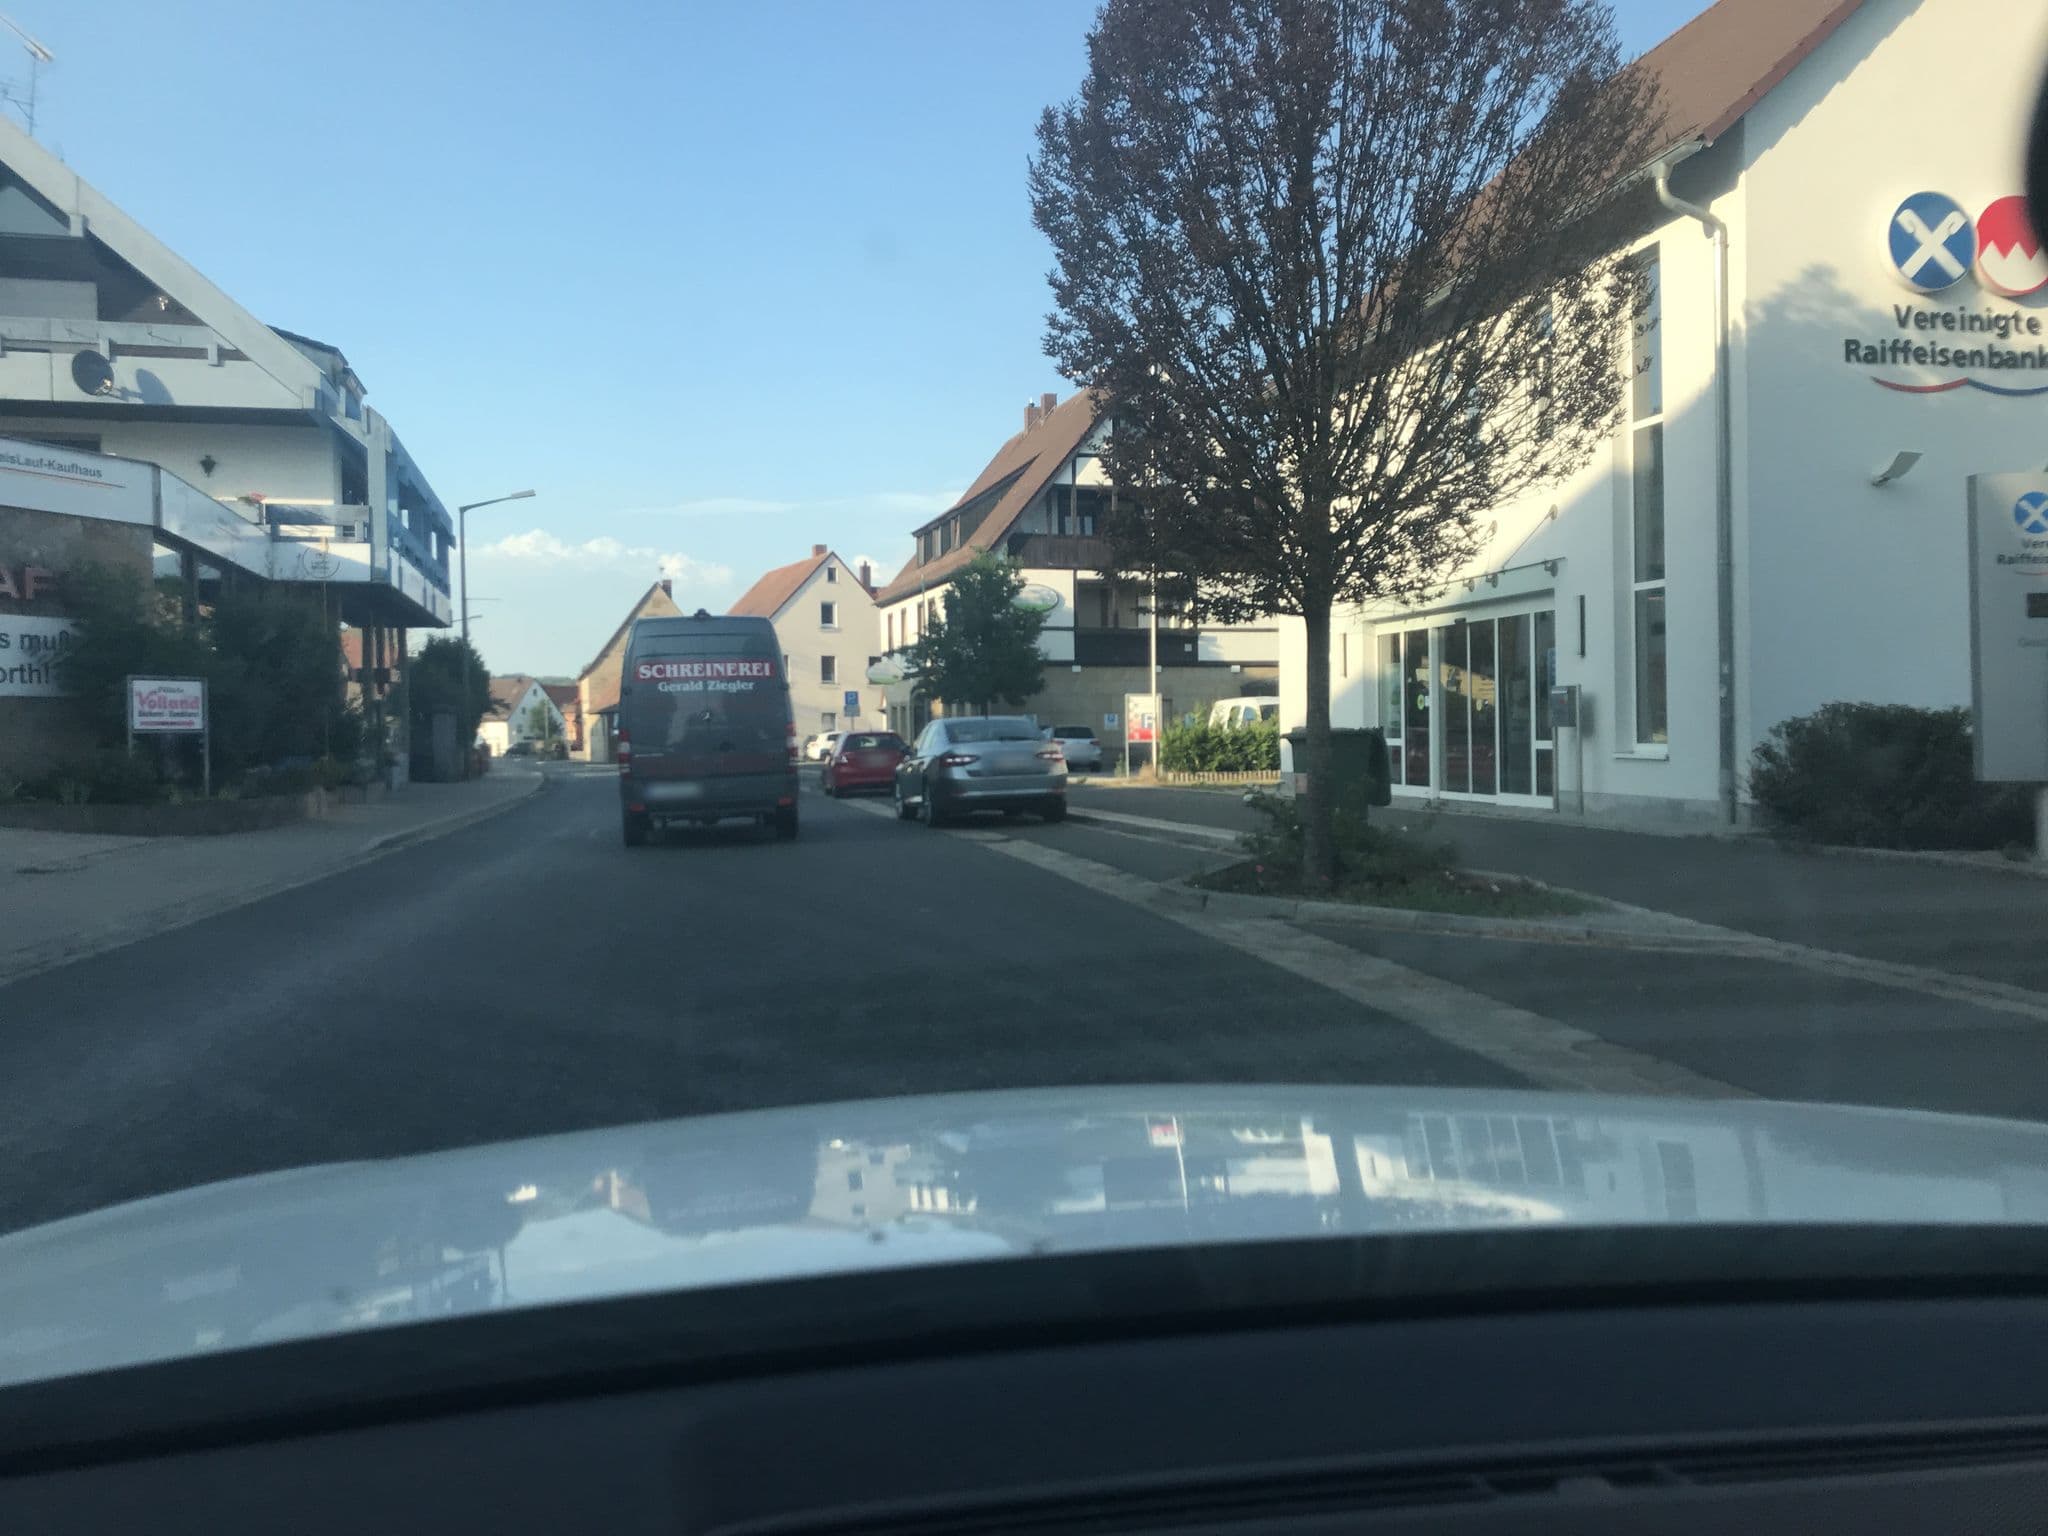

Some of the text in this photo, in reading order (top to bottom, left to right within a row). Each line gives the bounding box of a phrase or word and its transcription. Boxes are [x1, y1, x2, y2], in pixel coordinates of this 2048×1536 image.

[1893, 304, 2042, 339] Vereinigte
[639, 661, 771, 680] SCHREINEREI
[658, 680, 755, 693] Gerald Ziegler
